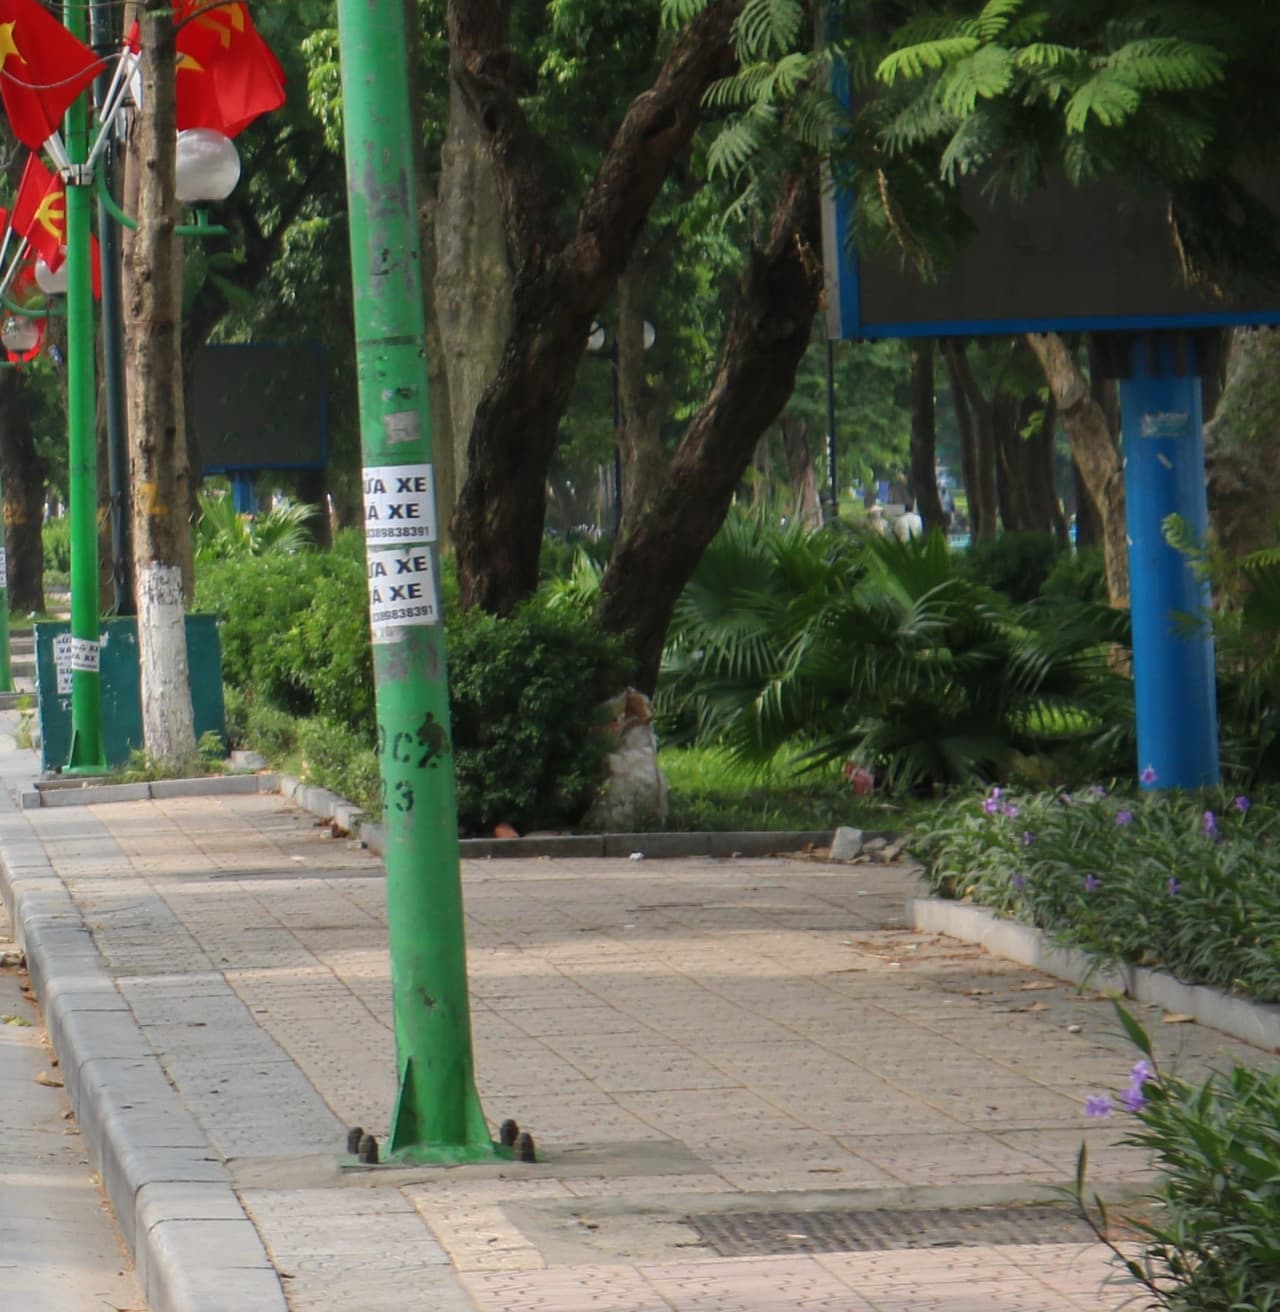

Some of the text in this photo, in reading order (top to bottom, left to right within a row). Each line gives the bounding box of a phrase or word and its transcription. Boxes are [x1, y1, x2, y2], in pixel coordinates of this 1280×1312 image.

[397, 477, 427, 493] XE
[388, 503, 420, 519] XE
[395, 556, 427, 574] XE
[390, 583, 422, 600] XE
